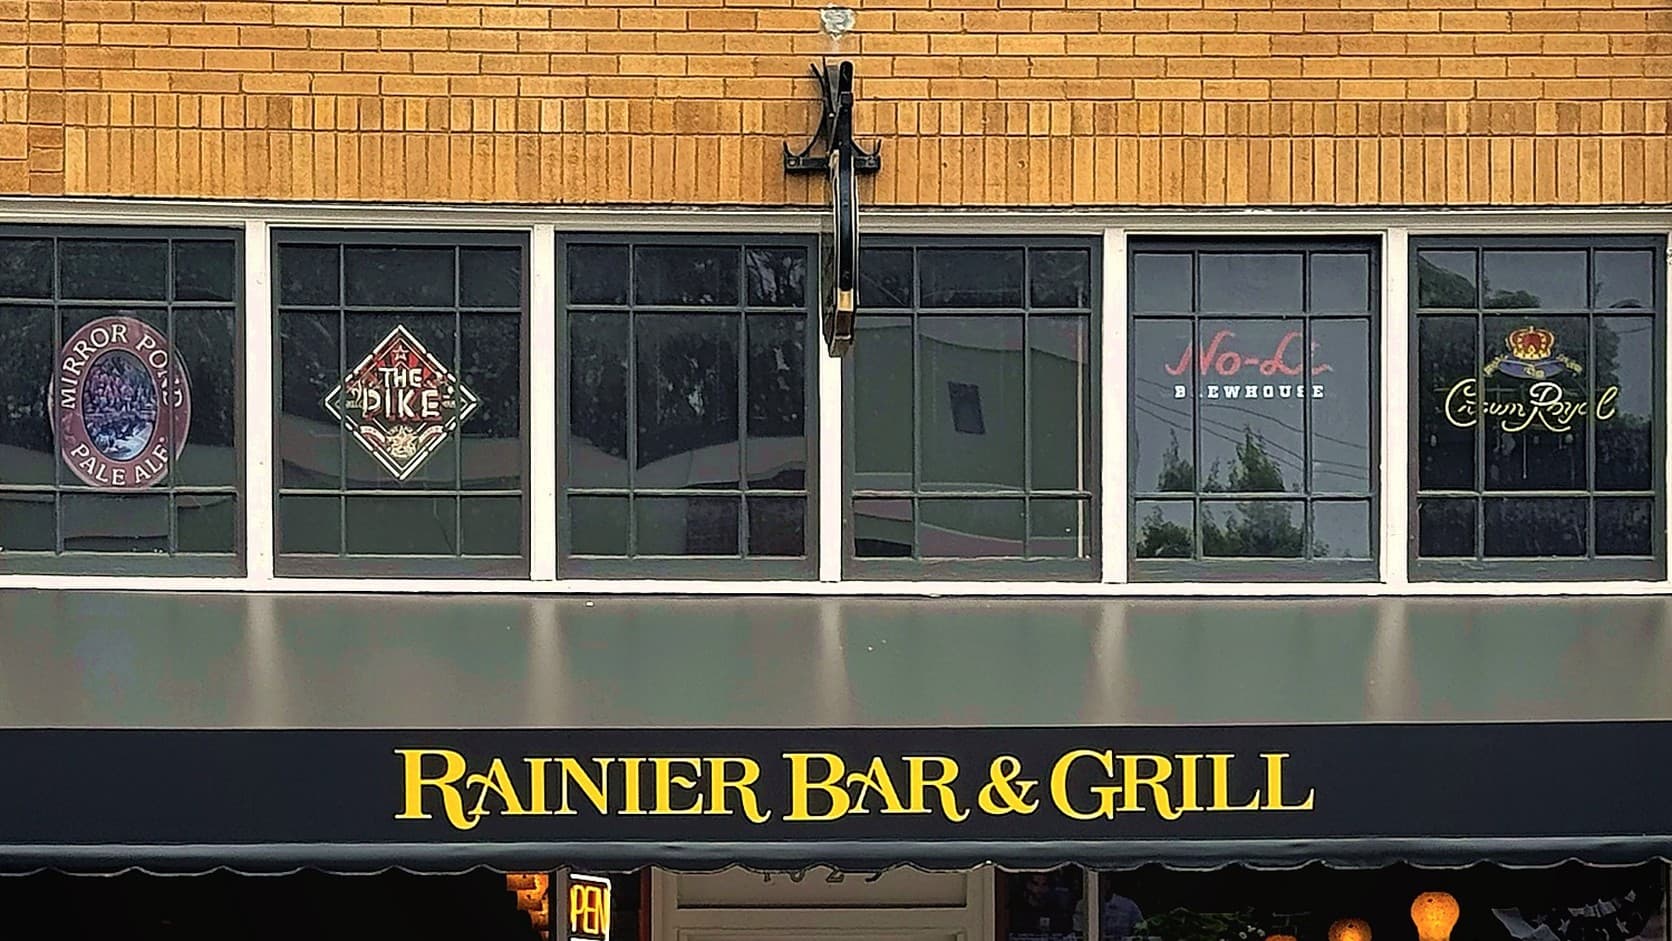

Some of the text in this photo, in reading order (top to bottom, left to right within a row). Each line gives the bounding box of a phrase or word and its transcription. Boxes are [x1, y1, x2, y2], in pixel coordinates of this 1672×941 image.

[61, 324, 128, 409] MIRROR
[378, 367, 423, 388] THE
[362, 388, 442, 418] PIKE
[1174, 385, 1324, 398] BEWHOUSE
[70, 443, 126, 486] PALE
[395, 748, 1315, 829] RAINIER BAR & GRILL
